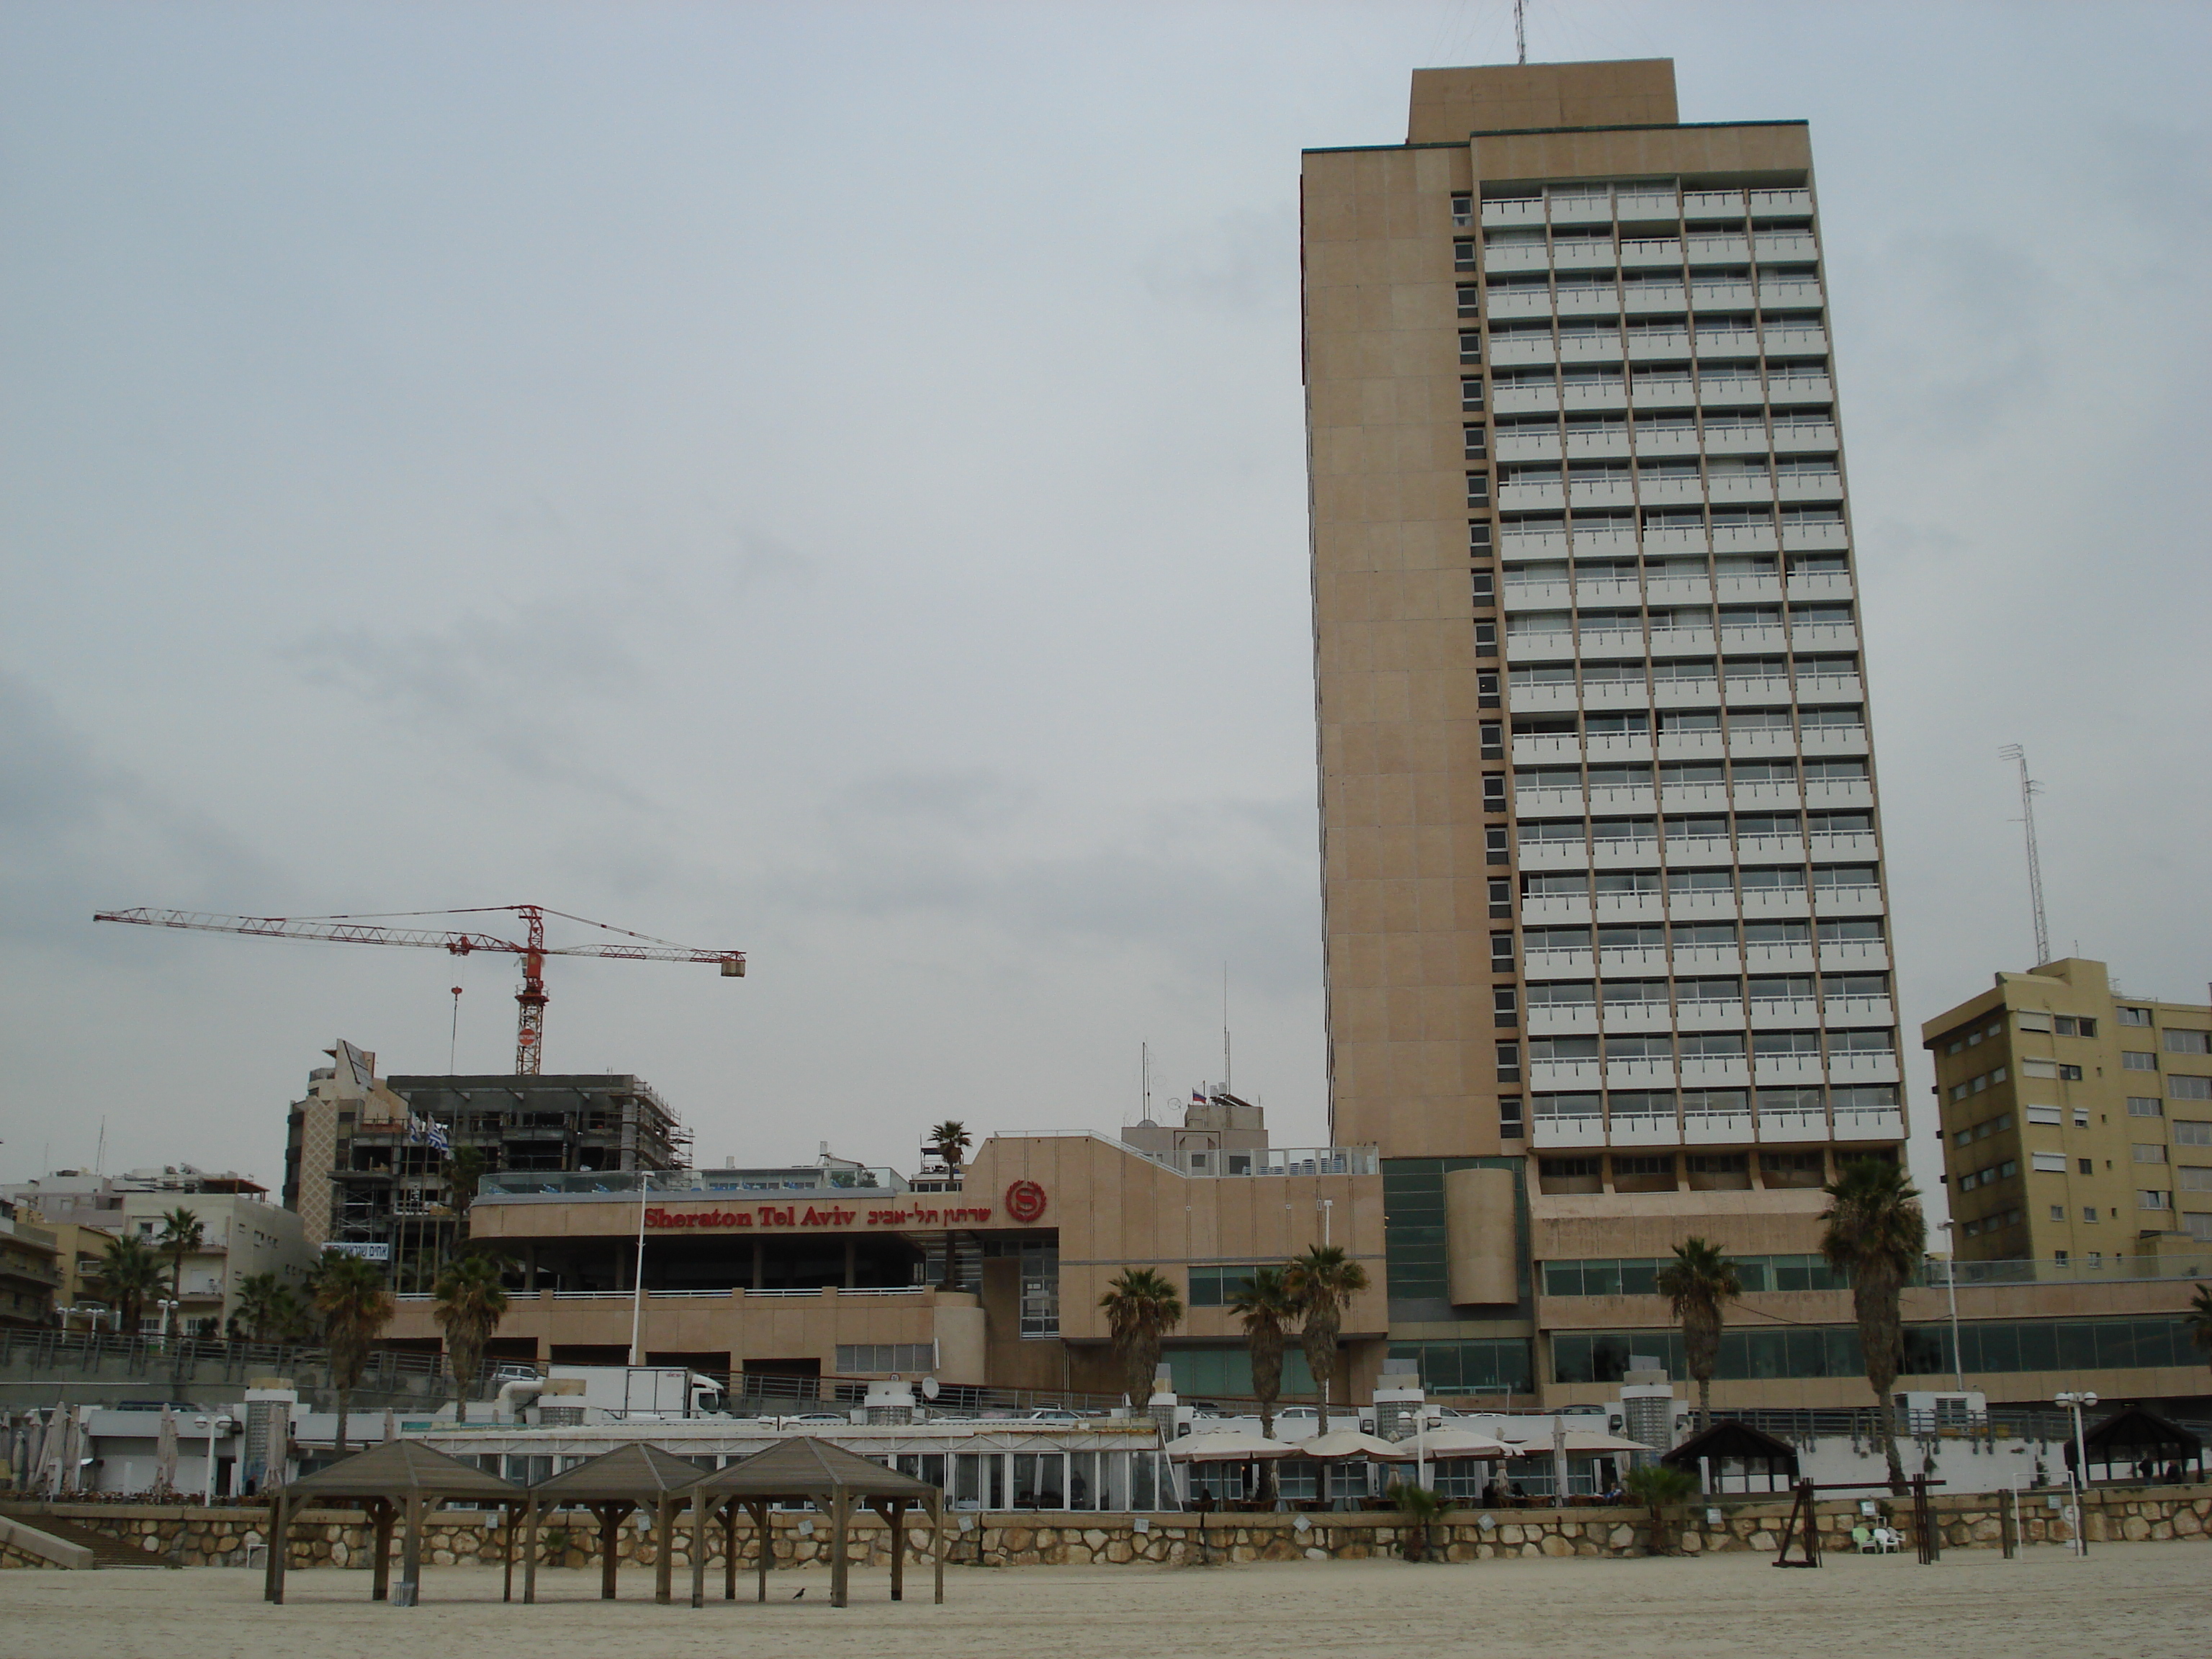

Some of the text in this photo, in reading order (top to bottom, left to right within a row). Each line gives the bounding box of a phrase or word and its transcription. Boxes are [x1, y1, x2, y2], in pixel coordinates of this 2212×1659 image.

[1016, 1187, 1038, 1213] S
[644, 1205, 856, 1227] Sheraton Tel Aviv
[867, 1201, 992, 1226] שרתון תל-אביב
